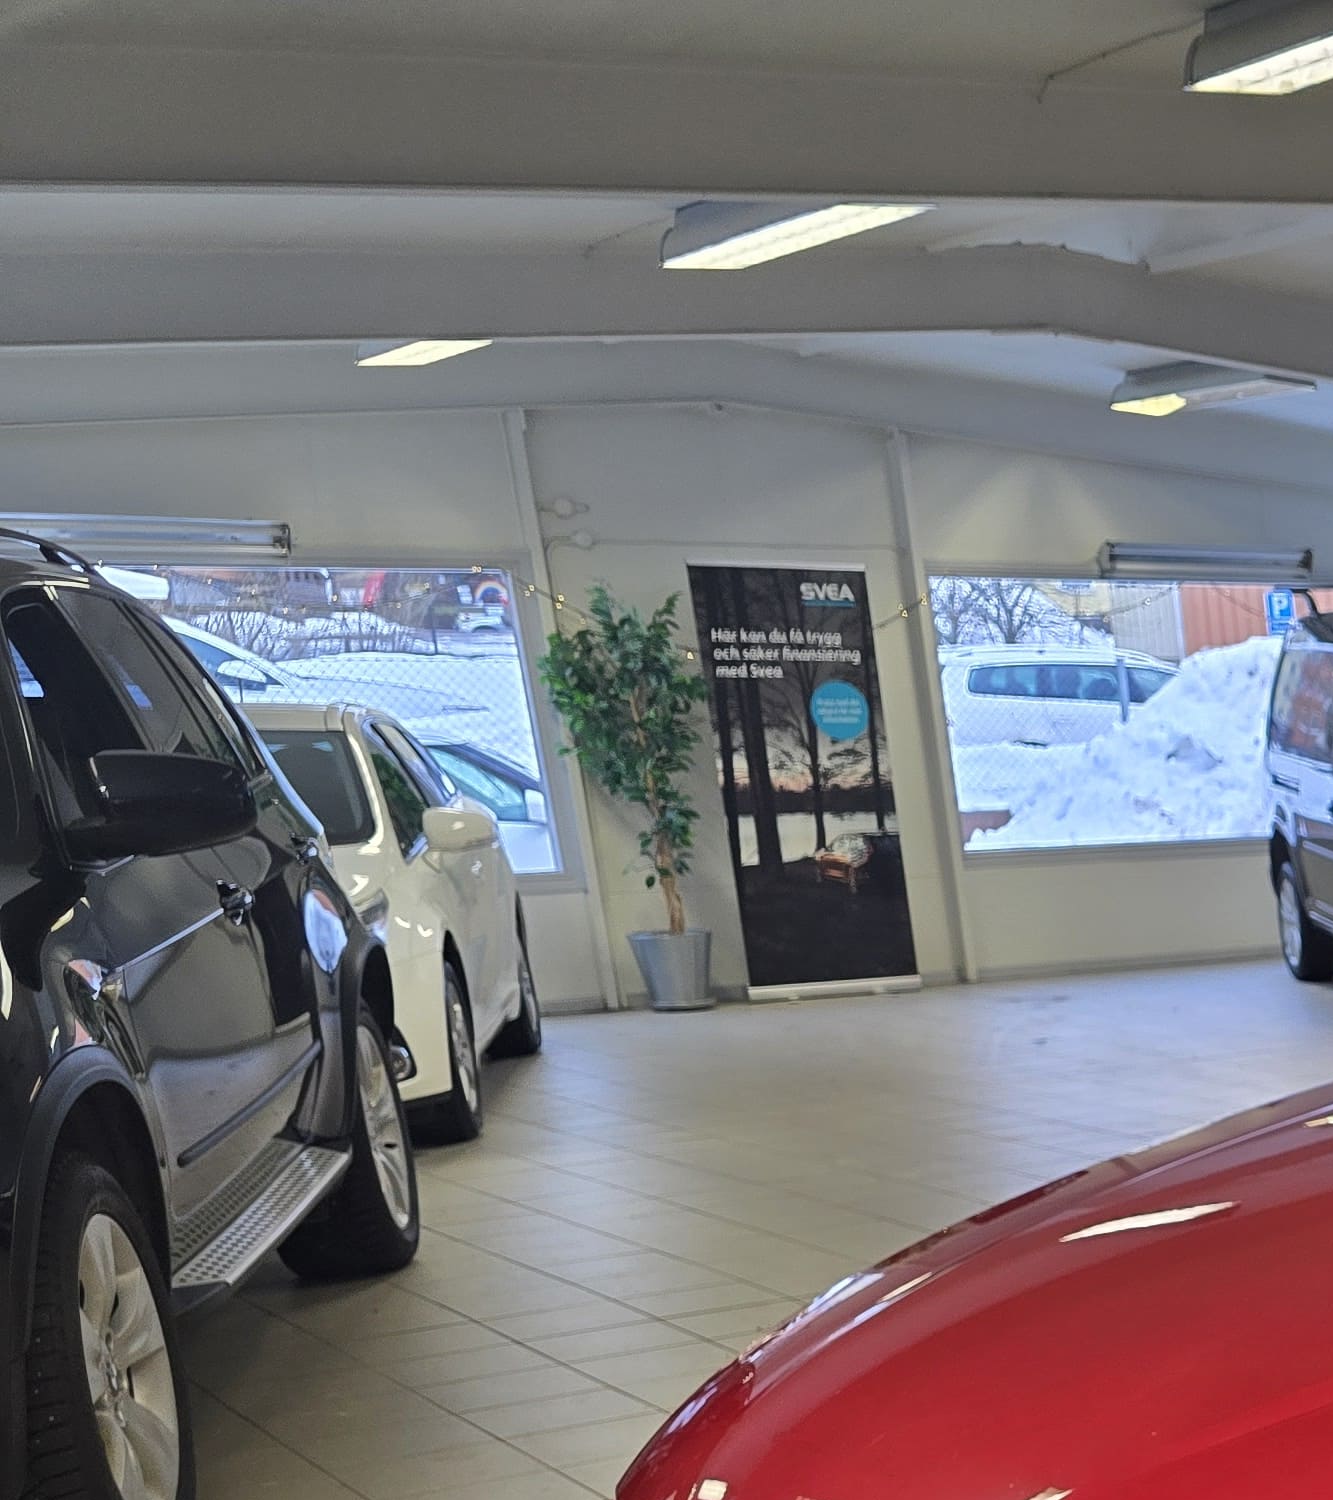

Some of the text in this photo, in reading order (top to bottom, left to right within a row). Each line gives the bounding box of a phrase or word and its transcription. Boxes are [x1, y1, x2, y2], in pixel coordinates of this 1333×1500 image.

[800, 582, 855, 602] SVEA
[1271, 593, 1289, 619] P
[711, 627, 842, 648] Här kan du få trygg
[713, 645, 861, 666] och säker finansiering
[716, 663, 784, 679] med Svea
